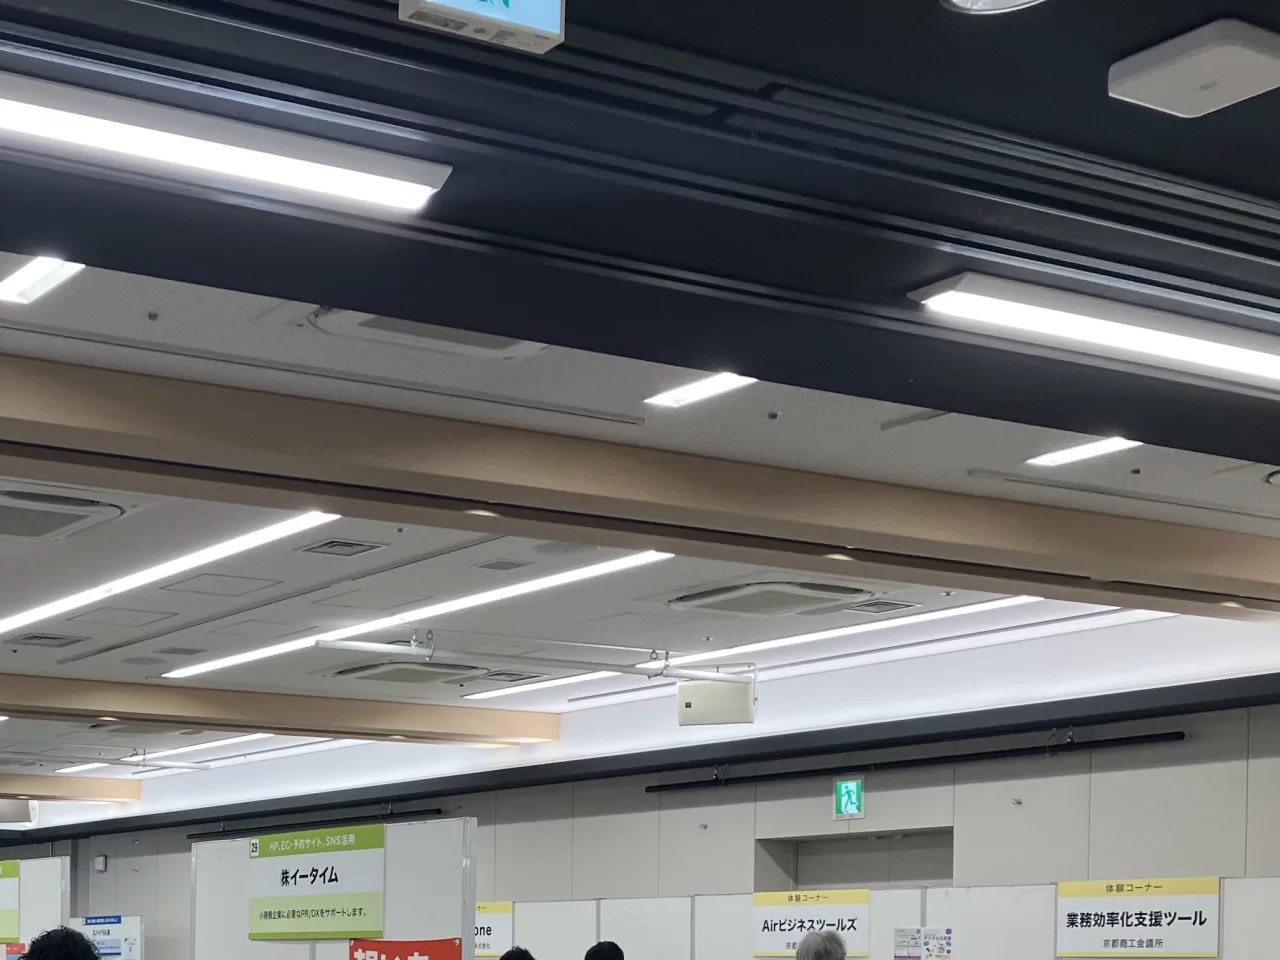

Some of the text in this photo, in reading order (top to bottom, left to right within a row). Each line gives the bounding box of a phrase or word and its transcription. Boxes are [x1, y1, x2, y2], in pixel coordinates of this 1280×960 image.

[251, 842, 258, 853] 29
[1106, 882, 1163, 893] 体験コーナー
[787, 893, 829, 902] 体験コーナー
[1066, 910, 1207, 928] 業務効率化支援ツール
[762, 917, 858, 933] Airビジネスツールズ
[1102, 938, 1164, 948] 京都商工会議所
